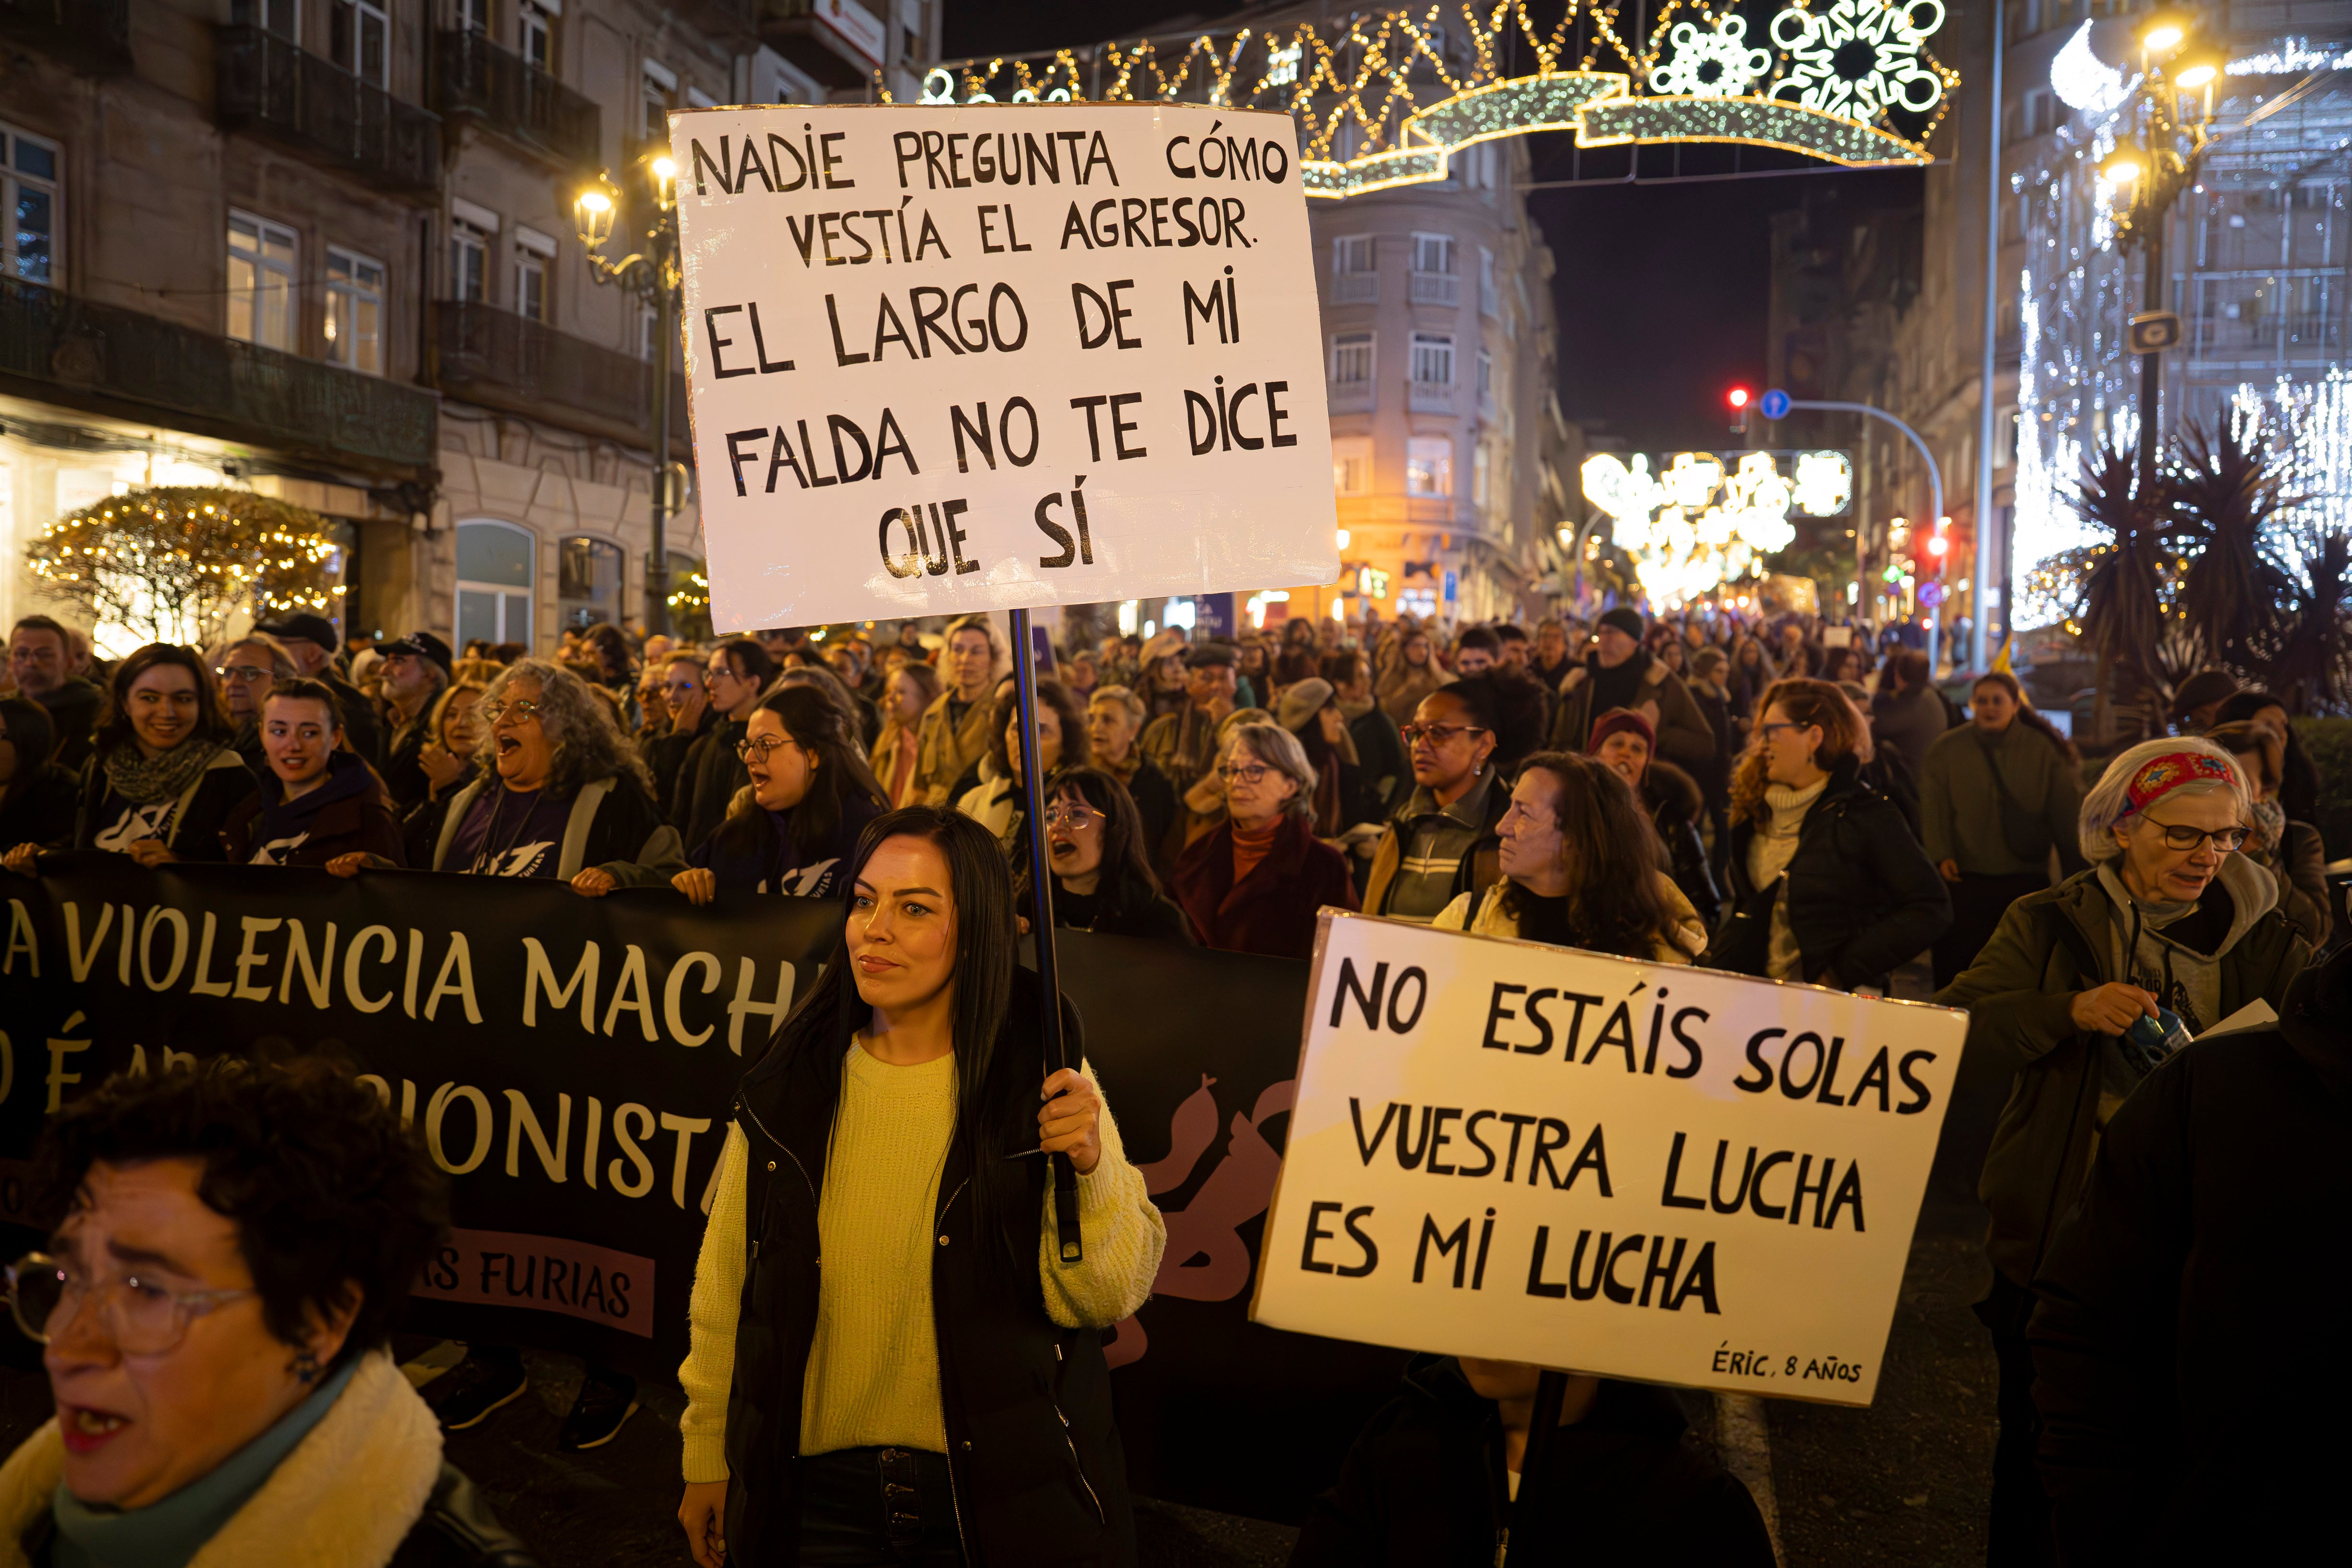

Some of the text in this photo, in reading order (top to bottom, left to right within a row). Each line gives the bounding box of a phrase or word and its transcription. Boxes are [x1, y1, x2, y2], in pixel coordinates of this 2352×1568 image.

[692, 120, 1288, 195] NADIE PREGUNTA CÓMO
[786, 195, 1258, 268] VESTÍA EL AGRESOR.
[705, 265, 1239, 379] EL LARGO DE MI
[725, 375, 1297, 497] FALDA NO TE DICE
[879, 475, 1093, 579] QUE SÍ
[3, 899, 829, 1057] A VIOLENCIA MACH
[45, 1010, 92, 1113] É
[1329, 958, 1937, 1115] NO ESTÁIS SOLAS
[1350, 1098, 1865, 1232] VUESTRA LUCHA
[481, 1252, 631, 1318] FURIAS
[1301, 1202, 1721, 1315] ES MI LUCHA
[1785, 1356, 1798, 1375] 8
[1803, 1356, 1862, 1383] AÑOS
